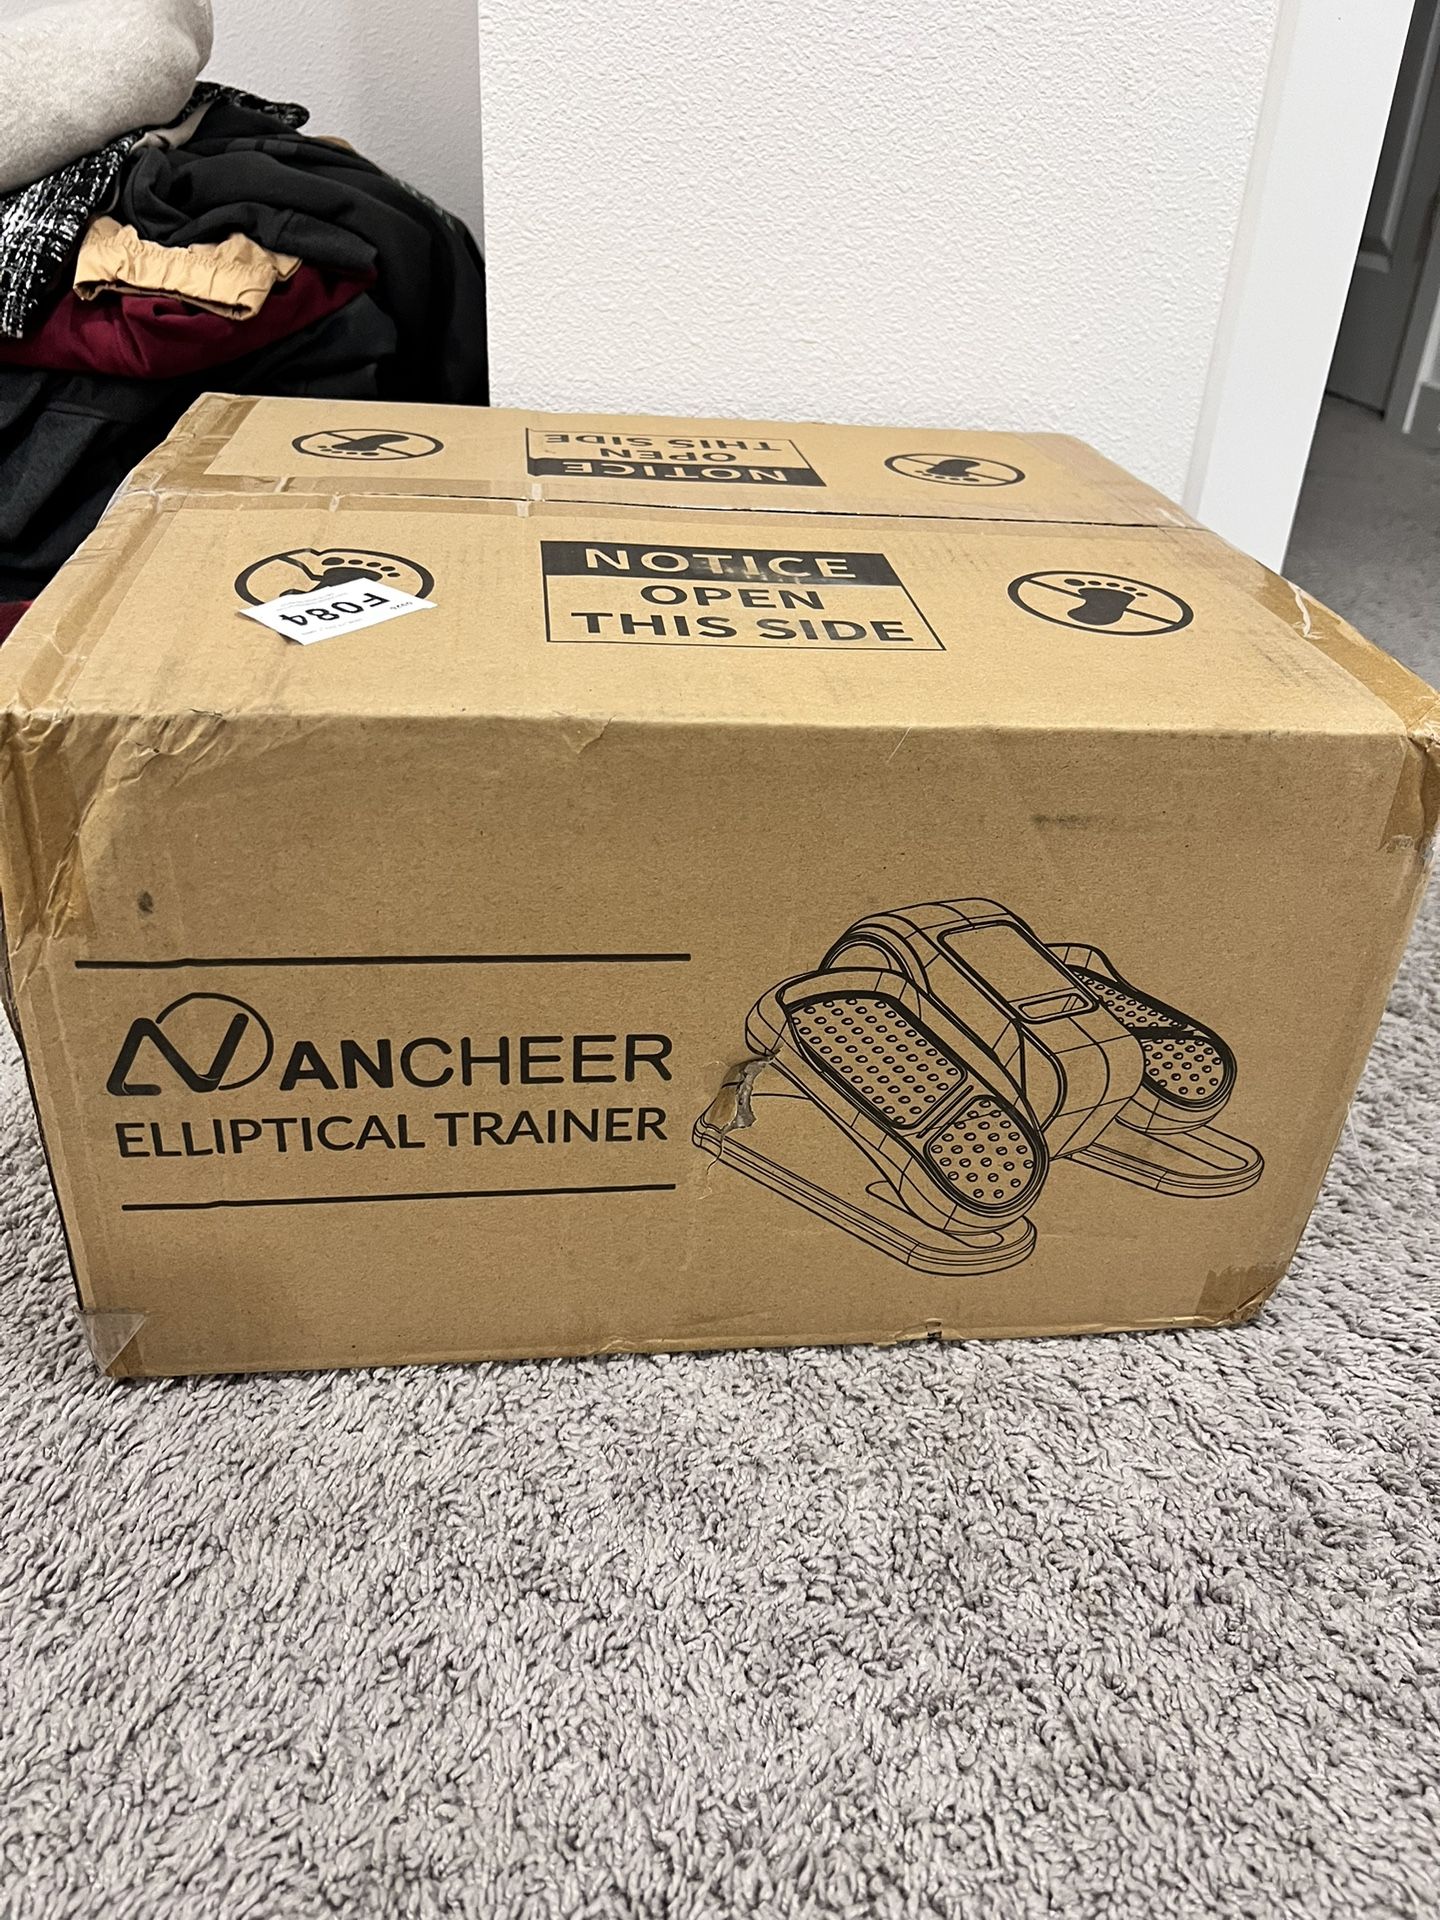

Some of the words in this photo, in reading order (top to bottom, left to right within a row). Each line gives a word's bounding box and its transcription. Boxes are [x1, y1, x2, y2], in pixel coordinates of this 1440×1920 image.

[544, 434, 653, 447] SIDE
[668, 438, 782, 451] THIS
[600, 448, 737, 463] OPEN
[563, 462, 789, 483] NOTICE
[585, 548, 856, 579] NOTICE
[278, 592, 390, 626] F084
[640, 585, 825, 610] OPEN
[571, 612, 738, 638] THIS
[756, 618, 914, 641] SIDE
[115, 1113, 426, 1158] ELLIPTICAL
[434, 1107, 668, 1147] TRAINER
